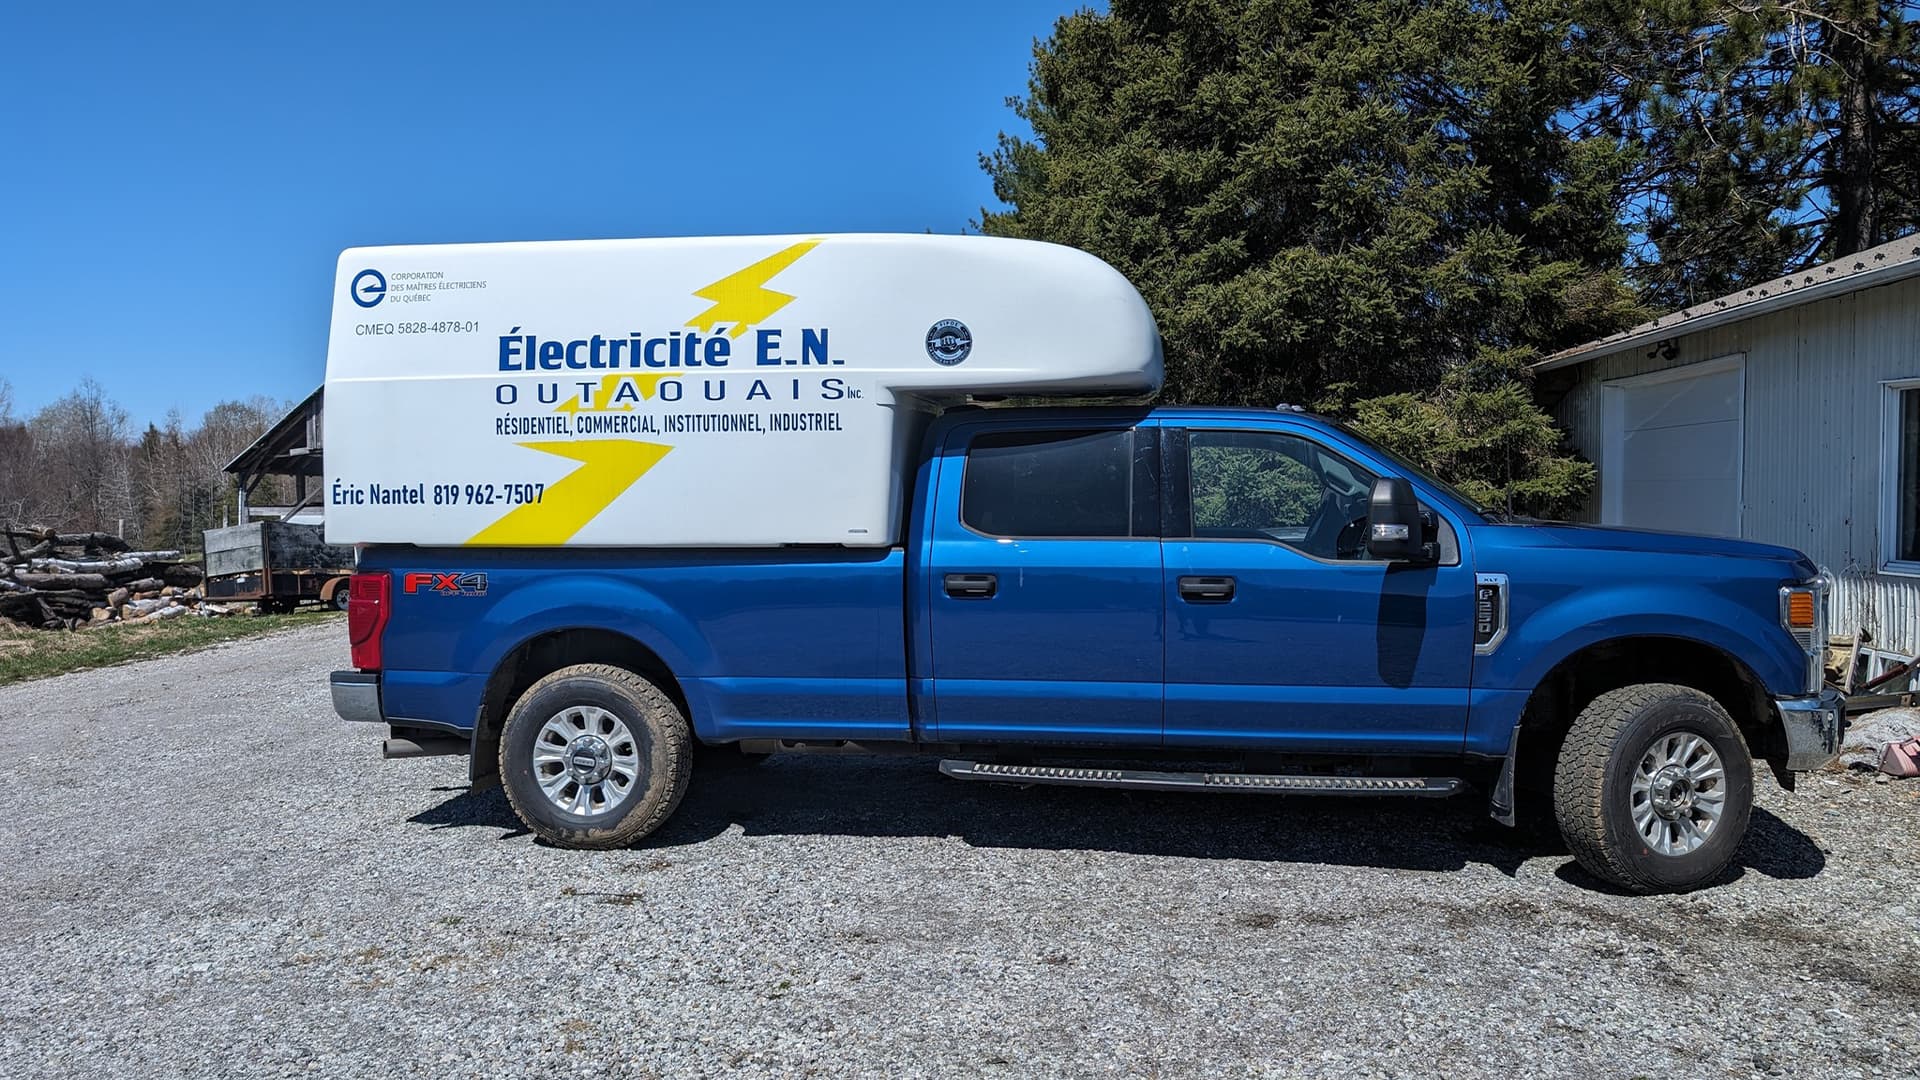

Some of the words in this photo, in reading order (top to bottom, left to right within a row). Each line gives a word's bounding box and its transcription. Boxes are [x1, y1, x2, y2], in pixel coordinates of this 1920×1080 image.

[390, 284, 404, 292] DES
[406, 281, 437, 291] MAÎTRES
[438, 280, 488, 290] ÉLECTRICIENS
[391, 271, 444, 281] CORPORATION
[390, 295, 401, 303] DU
[402, 293, 432, 304] QUÉBEC
[355, 323, 395, 336] CMEQ
[398, 320, 479, 334] 5828-4878-01
[498, 326, 731, 372] Électricité
[756, 328, 846, 367] E.N.
[495, 377, 845, 405] OUTAOUAIS
[495, 412, 574, 437] RÉSIDENTIEL,
[576, 414, 661, 436] COMMERCIAL,
[664, 413, 767, 435] INSTITUTIONNEL,
[769, 412, 843, 432] INDUSTRIEL
[332, 477, 365, 505] Éric
[369, 483, 425, 505] Nantel
[433, 484, 460, 505] 819
[465, 483, 545, 505] 962-7507
[404, 572, 488, 594] FX4
